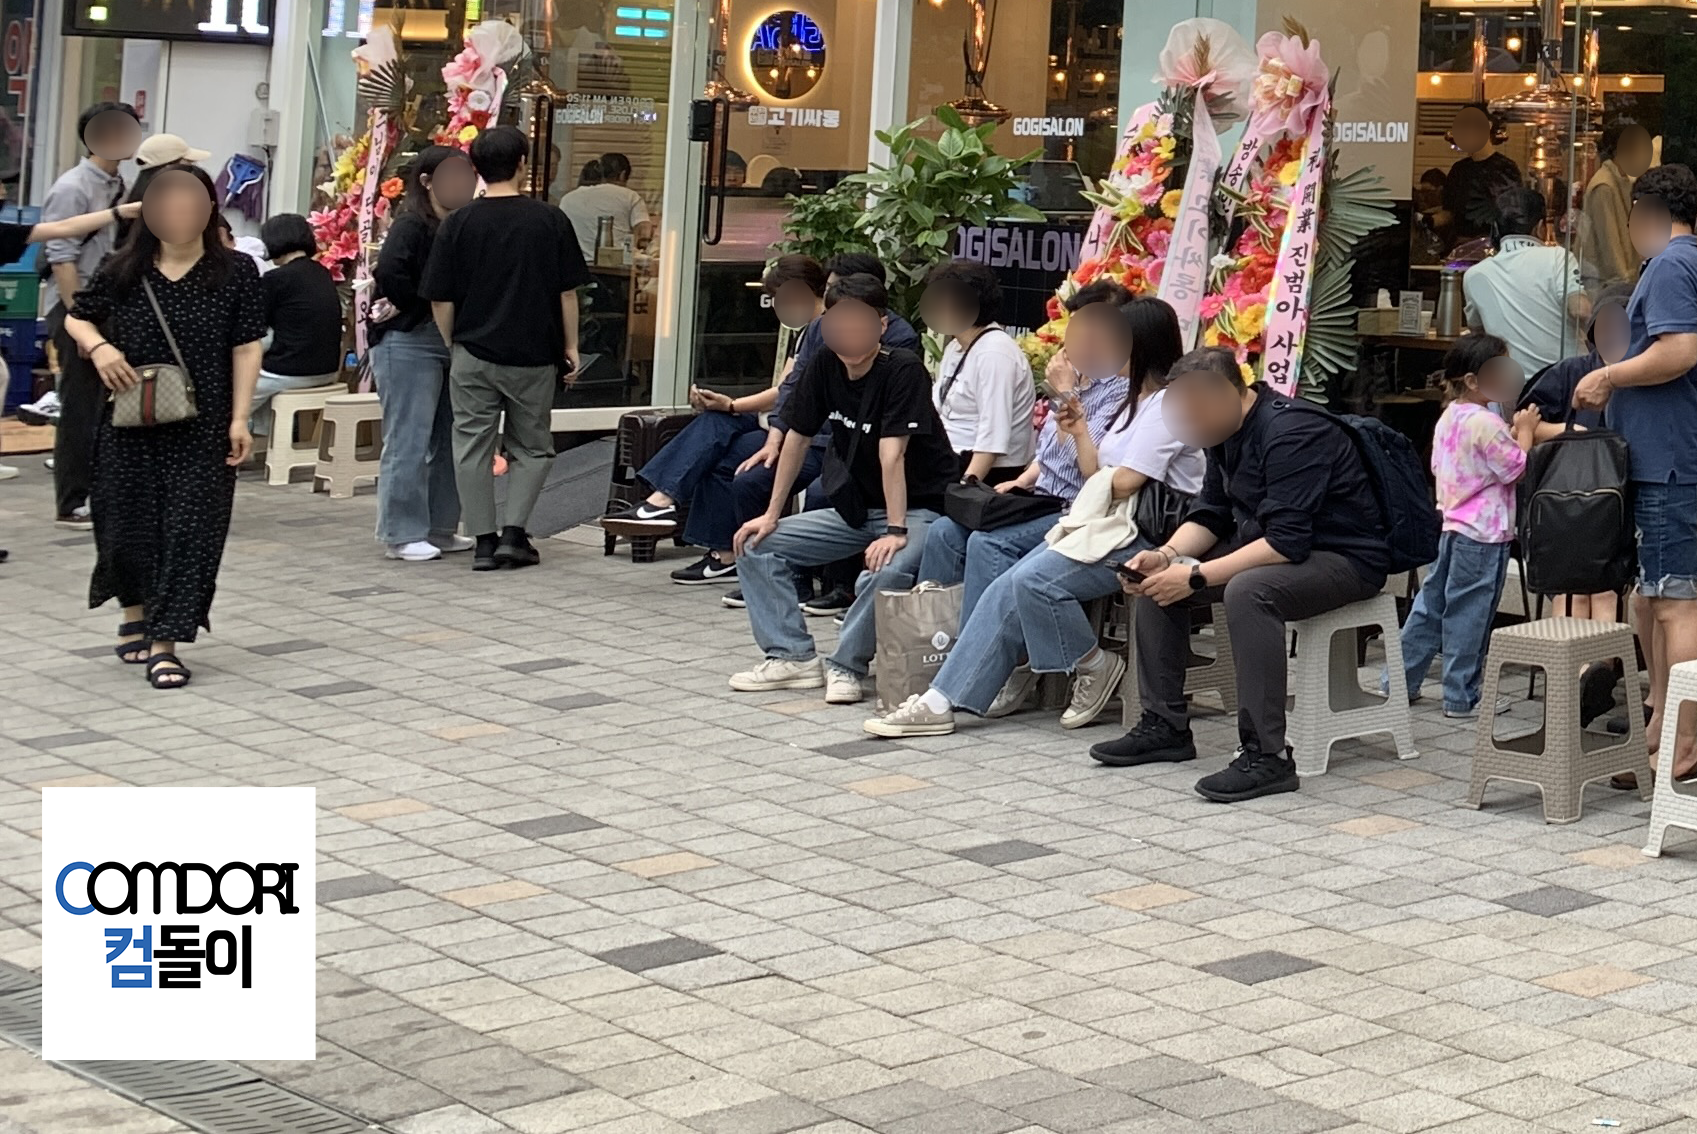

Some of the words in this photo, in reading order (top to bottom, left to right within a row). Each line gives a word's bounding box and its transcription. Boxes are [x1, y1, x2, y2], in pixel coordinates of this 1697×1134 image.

[1013, 116, 1086, 137] GOGISALON
[1333, 121, 1409, 143] OGISALON
[951, 225, 1082, 273] OGISALON
[1276, 241, 1310, 321] 진범아
[923, 652, 948, 664] LOT
